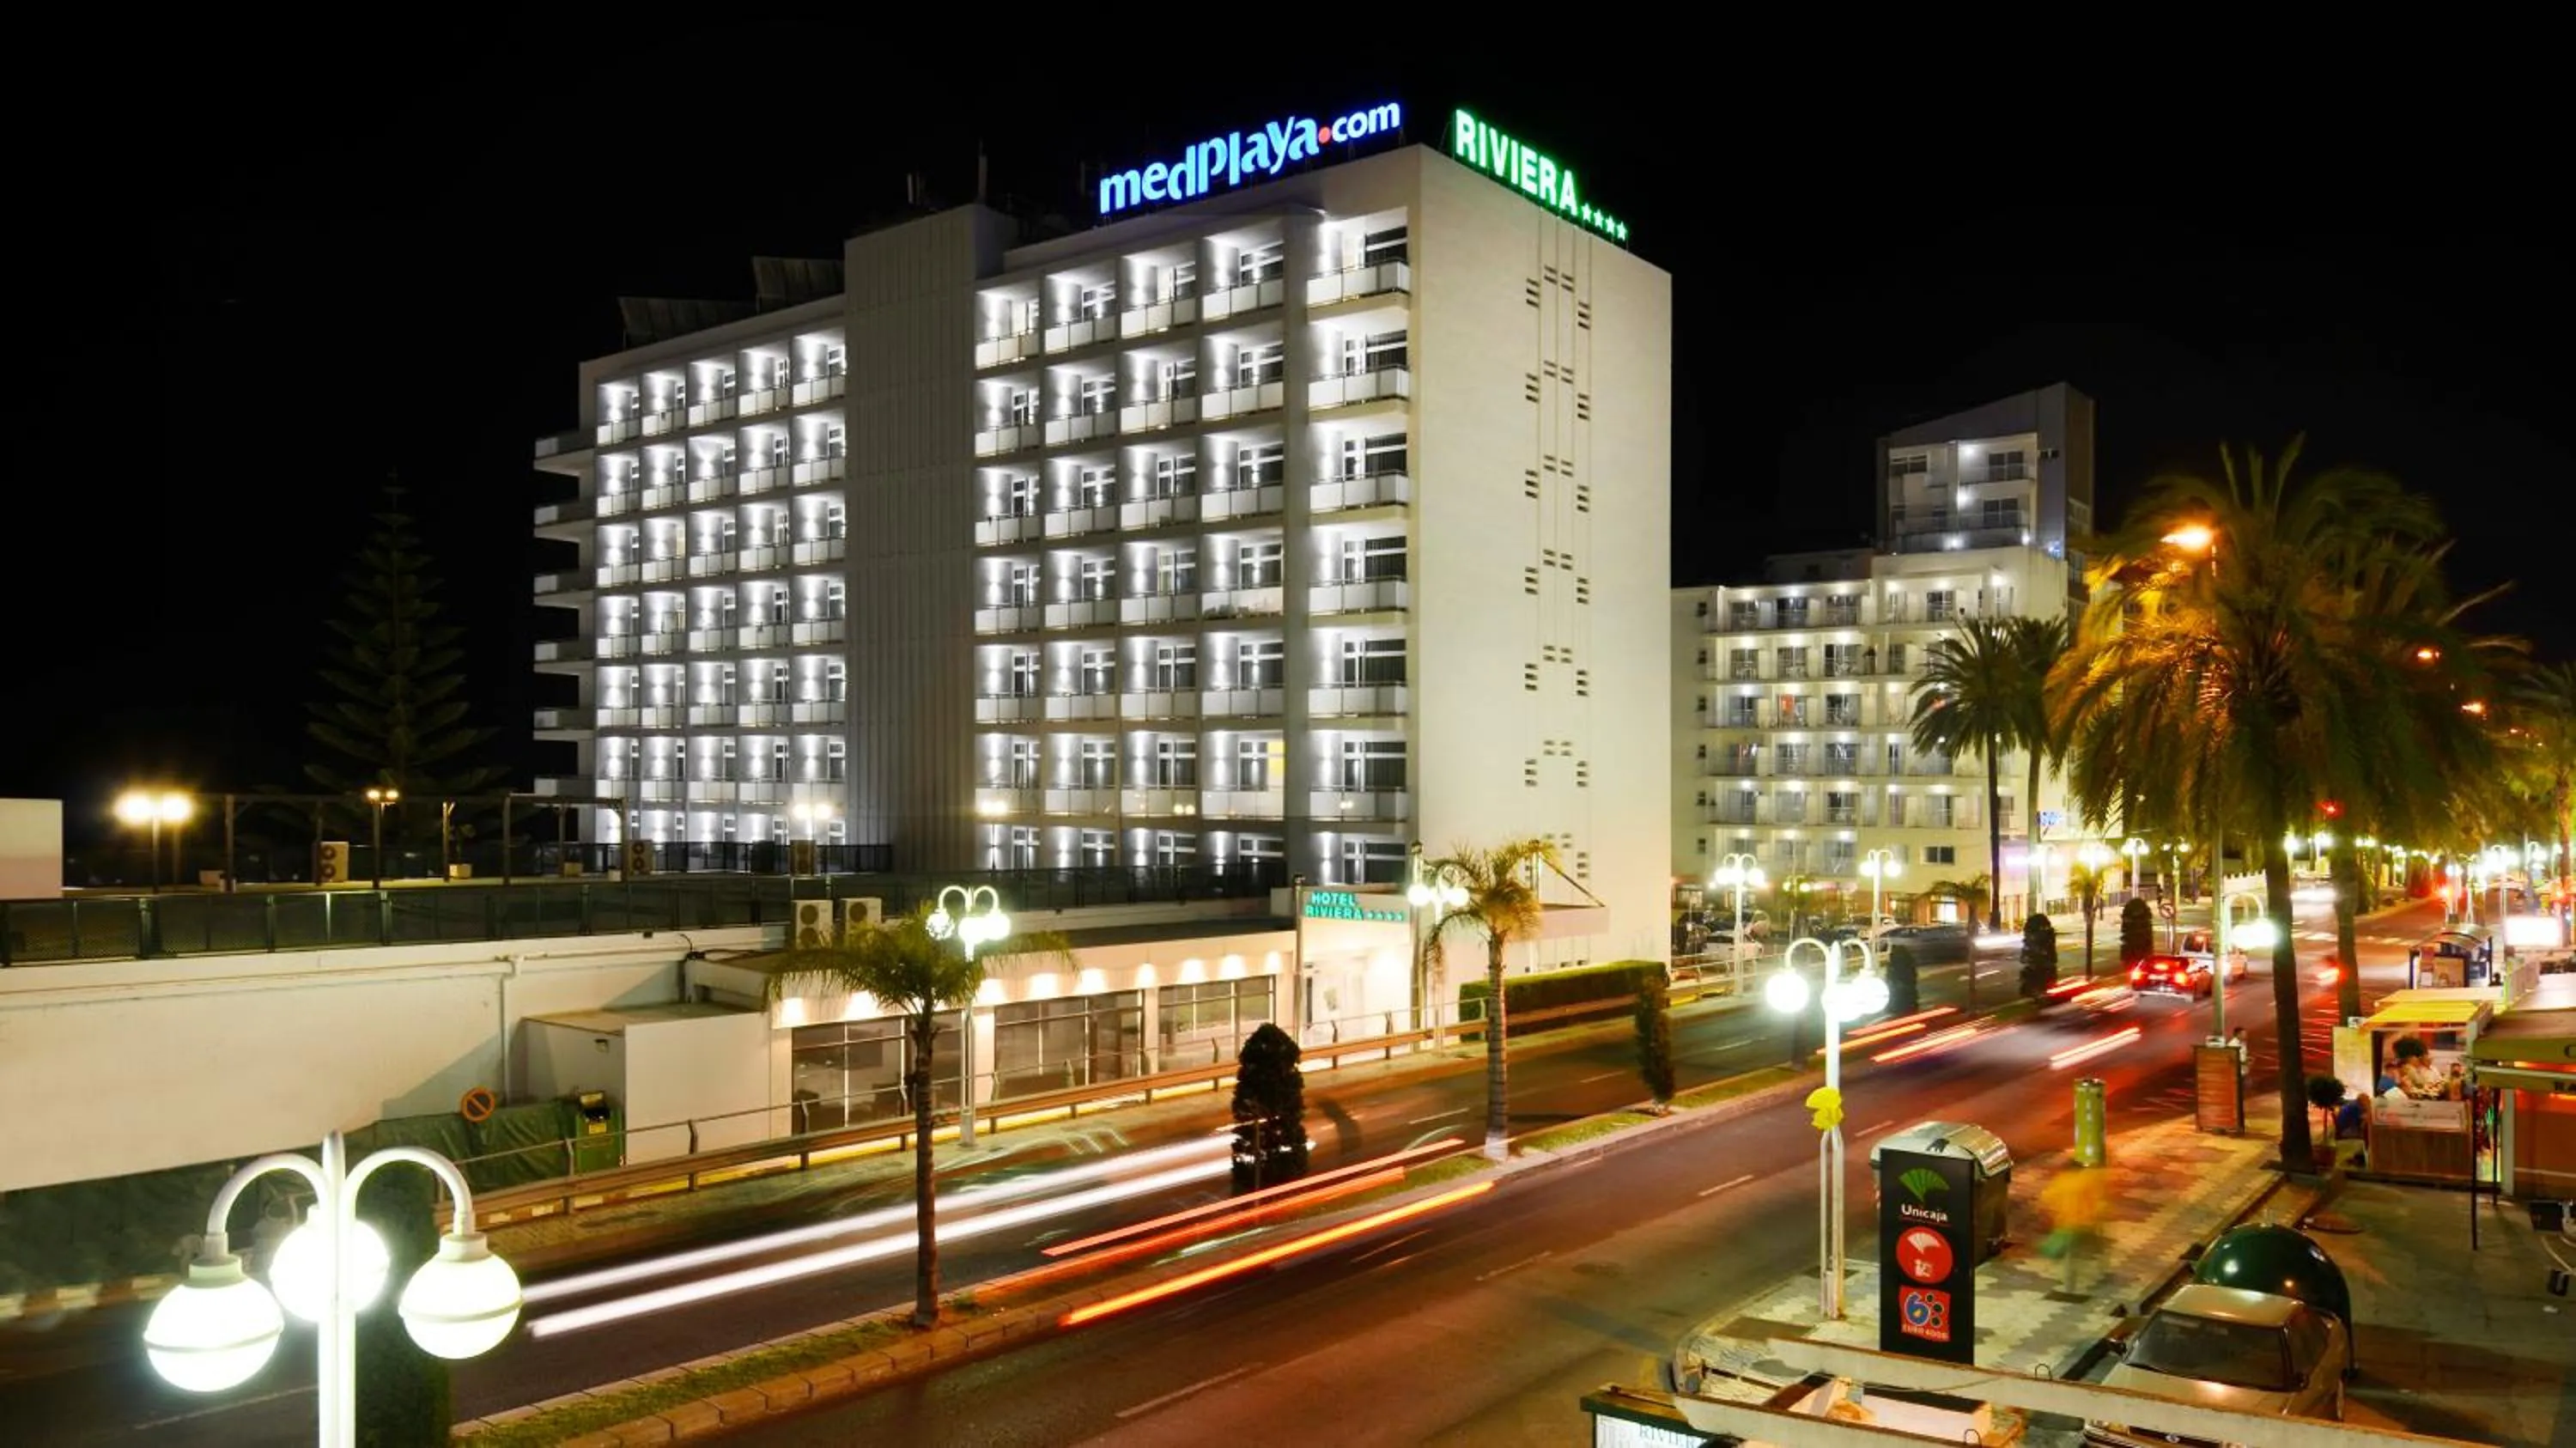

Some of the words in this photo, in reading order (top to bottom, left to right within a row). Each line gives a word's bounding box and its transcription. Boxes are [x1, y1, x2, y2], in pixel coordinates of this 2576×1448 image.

[1100, 102, 1400, 214] medplaya.com
[1455, 108, 1578, 216] RIVIERA
[1311, 891, 1356, 906] HOTEL
[1305, 904, 1364, 921] RIVIERA
[1901, 1203, 1948, 1222] Unicaja
[1639, 1424, 1698, 1448] RIVIER
